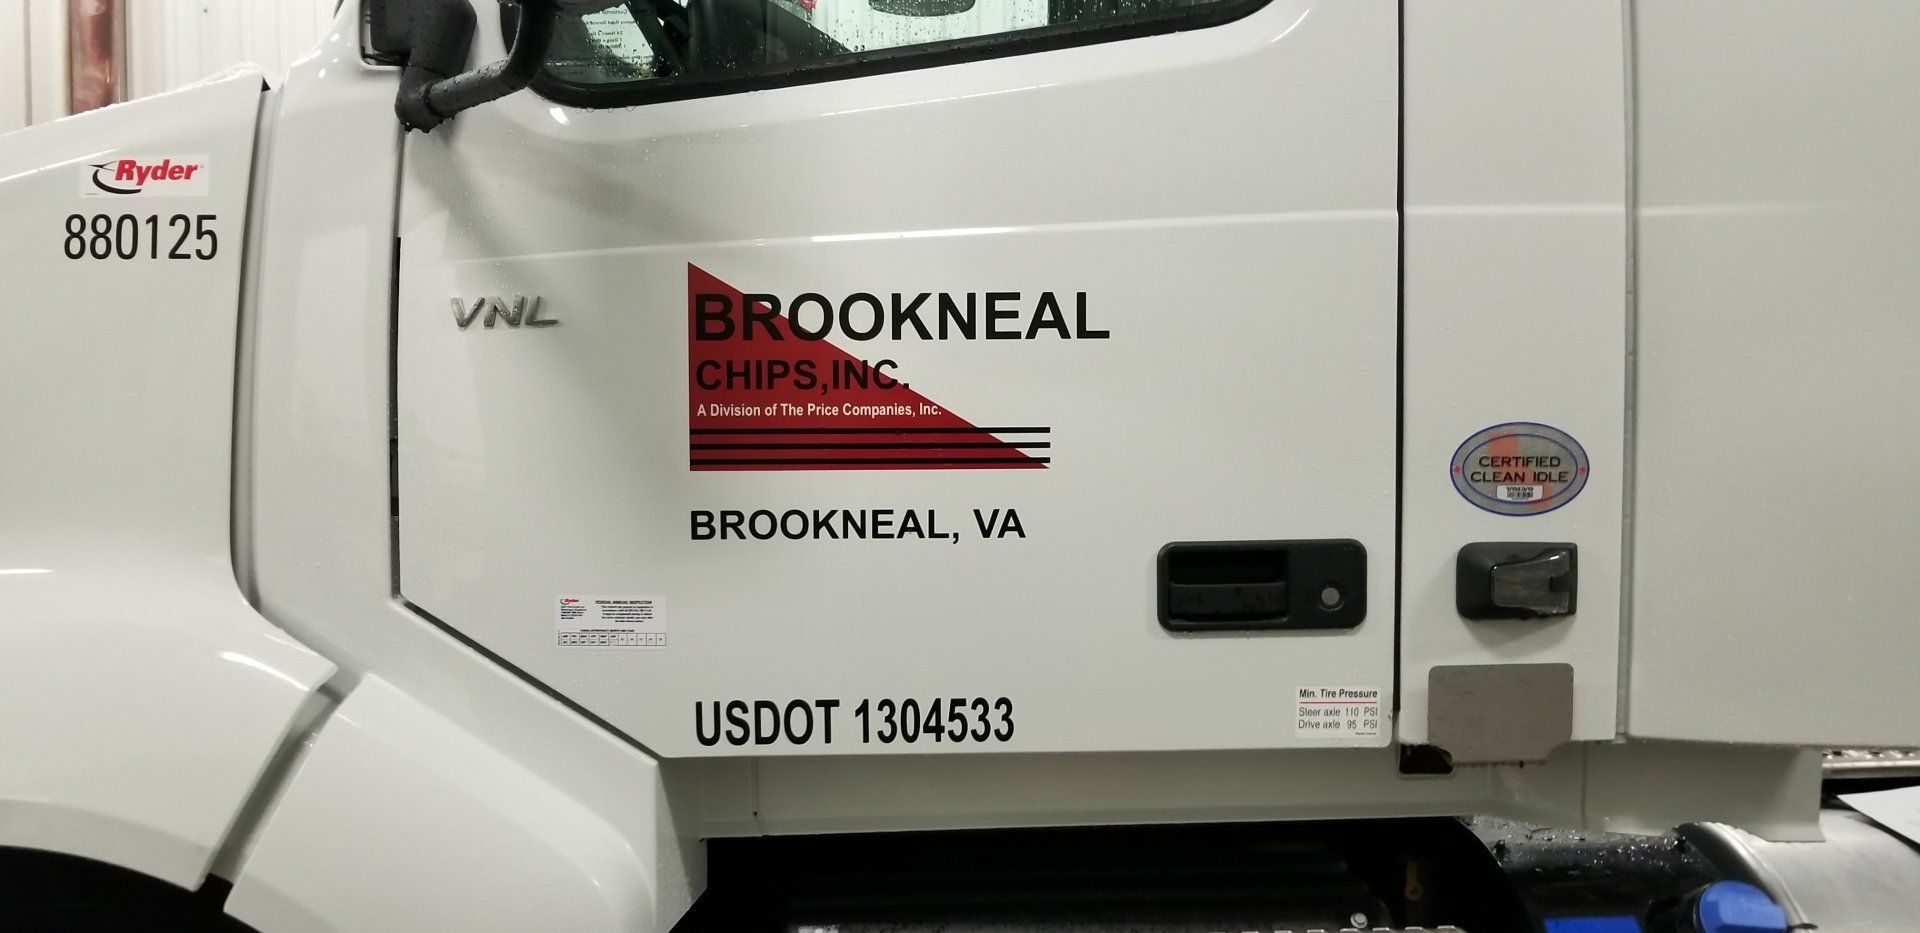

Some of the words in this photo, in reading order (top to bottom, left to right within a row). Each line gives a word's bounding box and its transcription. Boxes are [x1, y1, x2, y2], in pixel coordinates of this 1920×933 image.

[115, 159, 199, 186] Ryder
[64, 213, 218, 260] 880125
[450, 295, 559, 328] VNL
[695, 291, 1110, 341] BROOKNEAL
[696, 359, 910, 395] CHIPS,INC.
[697, 404, 707, 416] A
[710, 403, 761, 416] Division
[765, 403, 778, 416] of
[781, 403, 804, 416] The
[807, 403, 839, 416] Price
[842, 403, 916, 419] Companies,
[919, 402, 942, 416] Inc.
[1478, 456, 1561, 468] CERTIFIED
[1470, 471, 1525, 482] CLEAN
[1533, 471, 1569, 482] IDLE
[691, 509, 960, 545] BROOKNEAL,
[973, 508, 1026, 538] VA
[1299, 688, 1317, 698] Min.
[1320, 688, 1336, 698] Tire
[1339, 688, 1378, 698] Pressure
[695, 699, 840, 746] USDOT
[854, 697, 1015, 744] 1304533
[1298, 719, 1320, 729] Drive
[1323, 719, 1340, 729] axle
[1347, 719, 1357, 729] 95
[1363, 719, 1378, 729] PSI
[1299, 707, 1321, 717] Steer
[1323, 707, 1340, 716] axle
[1345, 707, 1359, 717] 110
[1363, 706, 1378, 716] PSI
